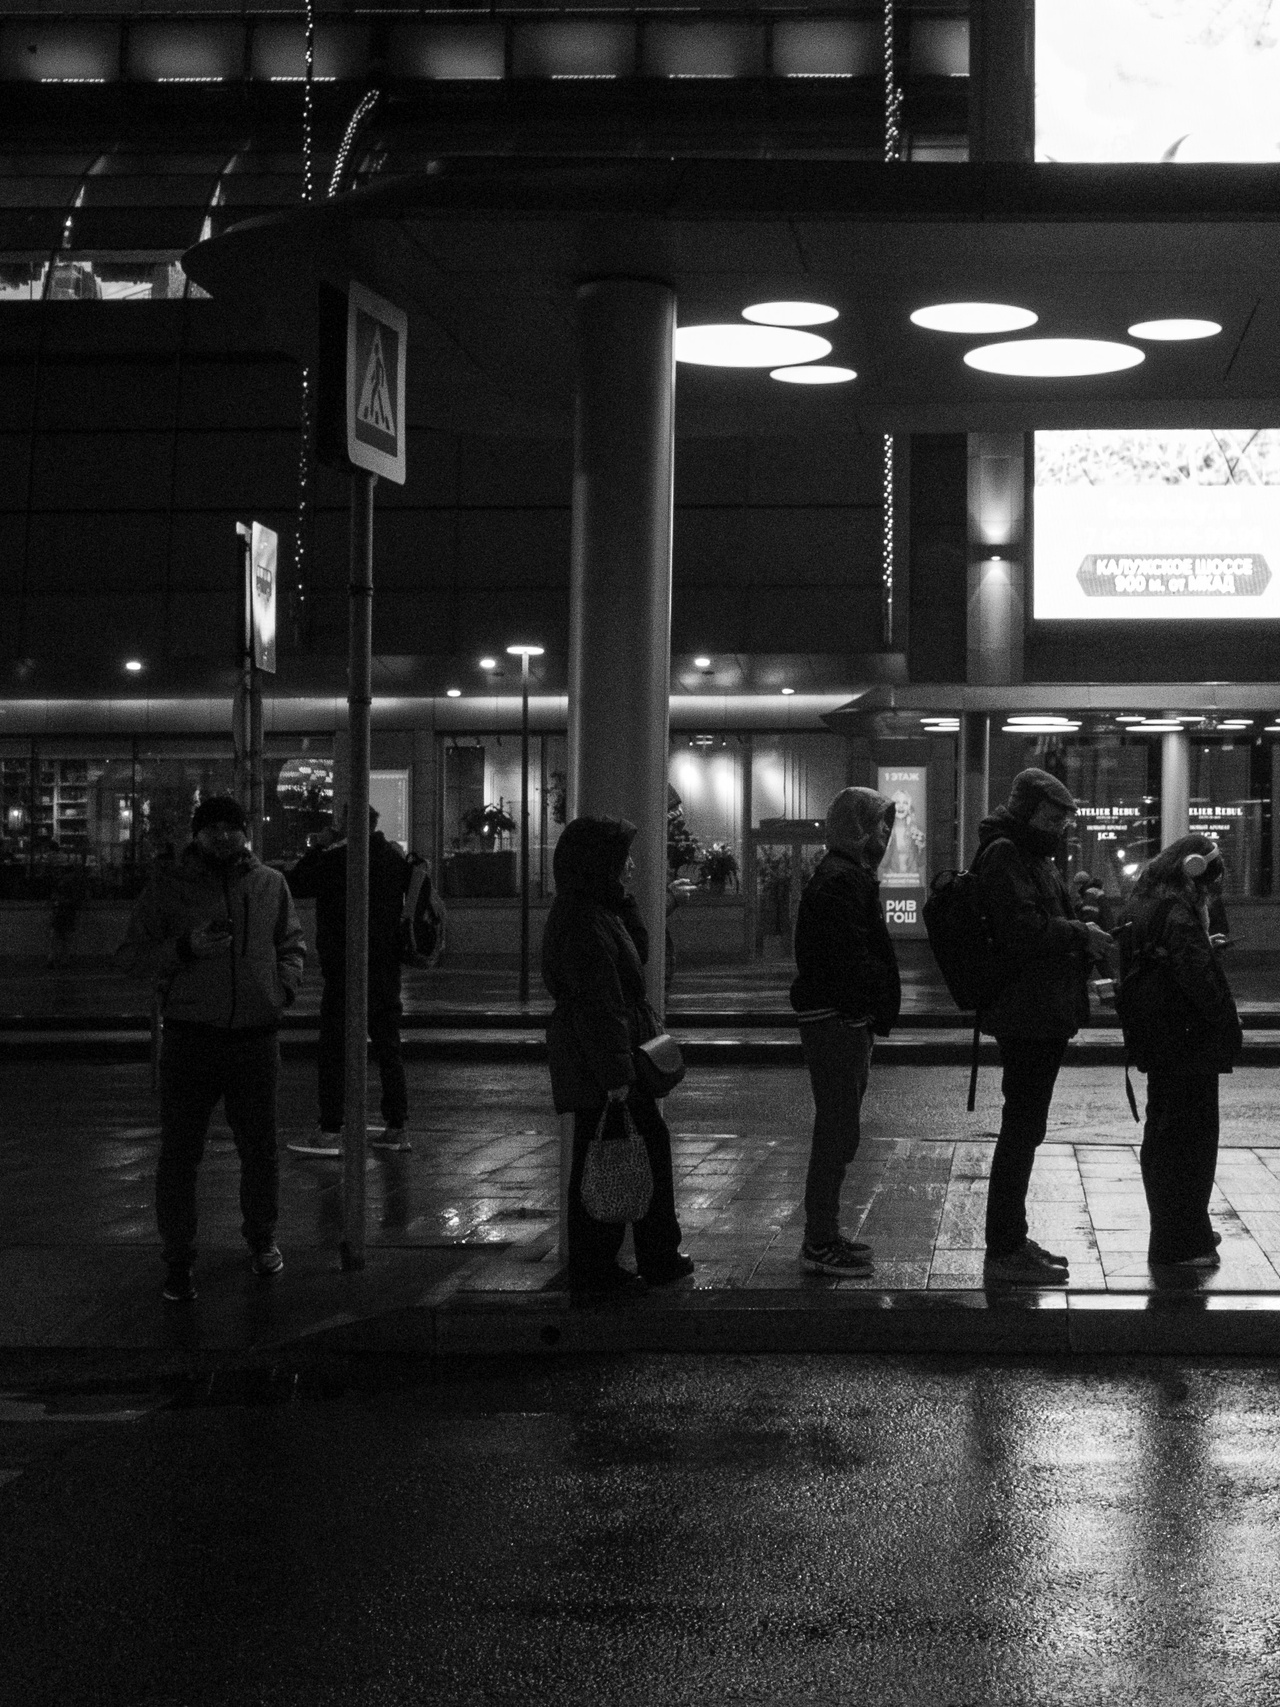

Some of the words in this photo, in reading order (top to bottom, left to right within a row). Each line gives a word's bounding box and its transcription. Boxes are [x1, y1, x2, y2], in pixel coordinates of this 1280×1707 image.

[1097, 558, 1193, 575] КАЛУЖСКОЕ
[1195, 558, 1253, 575] ШОССЕ
[1115, 575, 1146, 592] 900
[1188, 575, 1235, 594] МКАД
[890, 772, 920, 782] ЭТАЖ
[886, 900, 917, 912] РИВ
[886, 911, 917, 924] ГОШ
